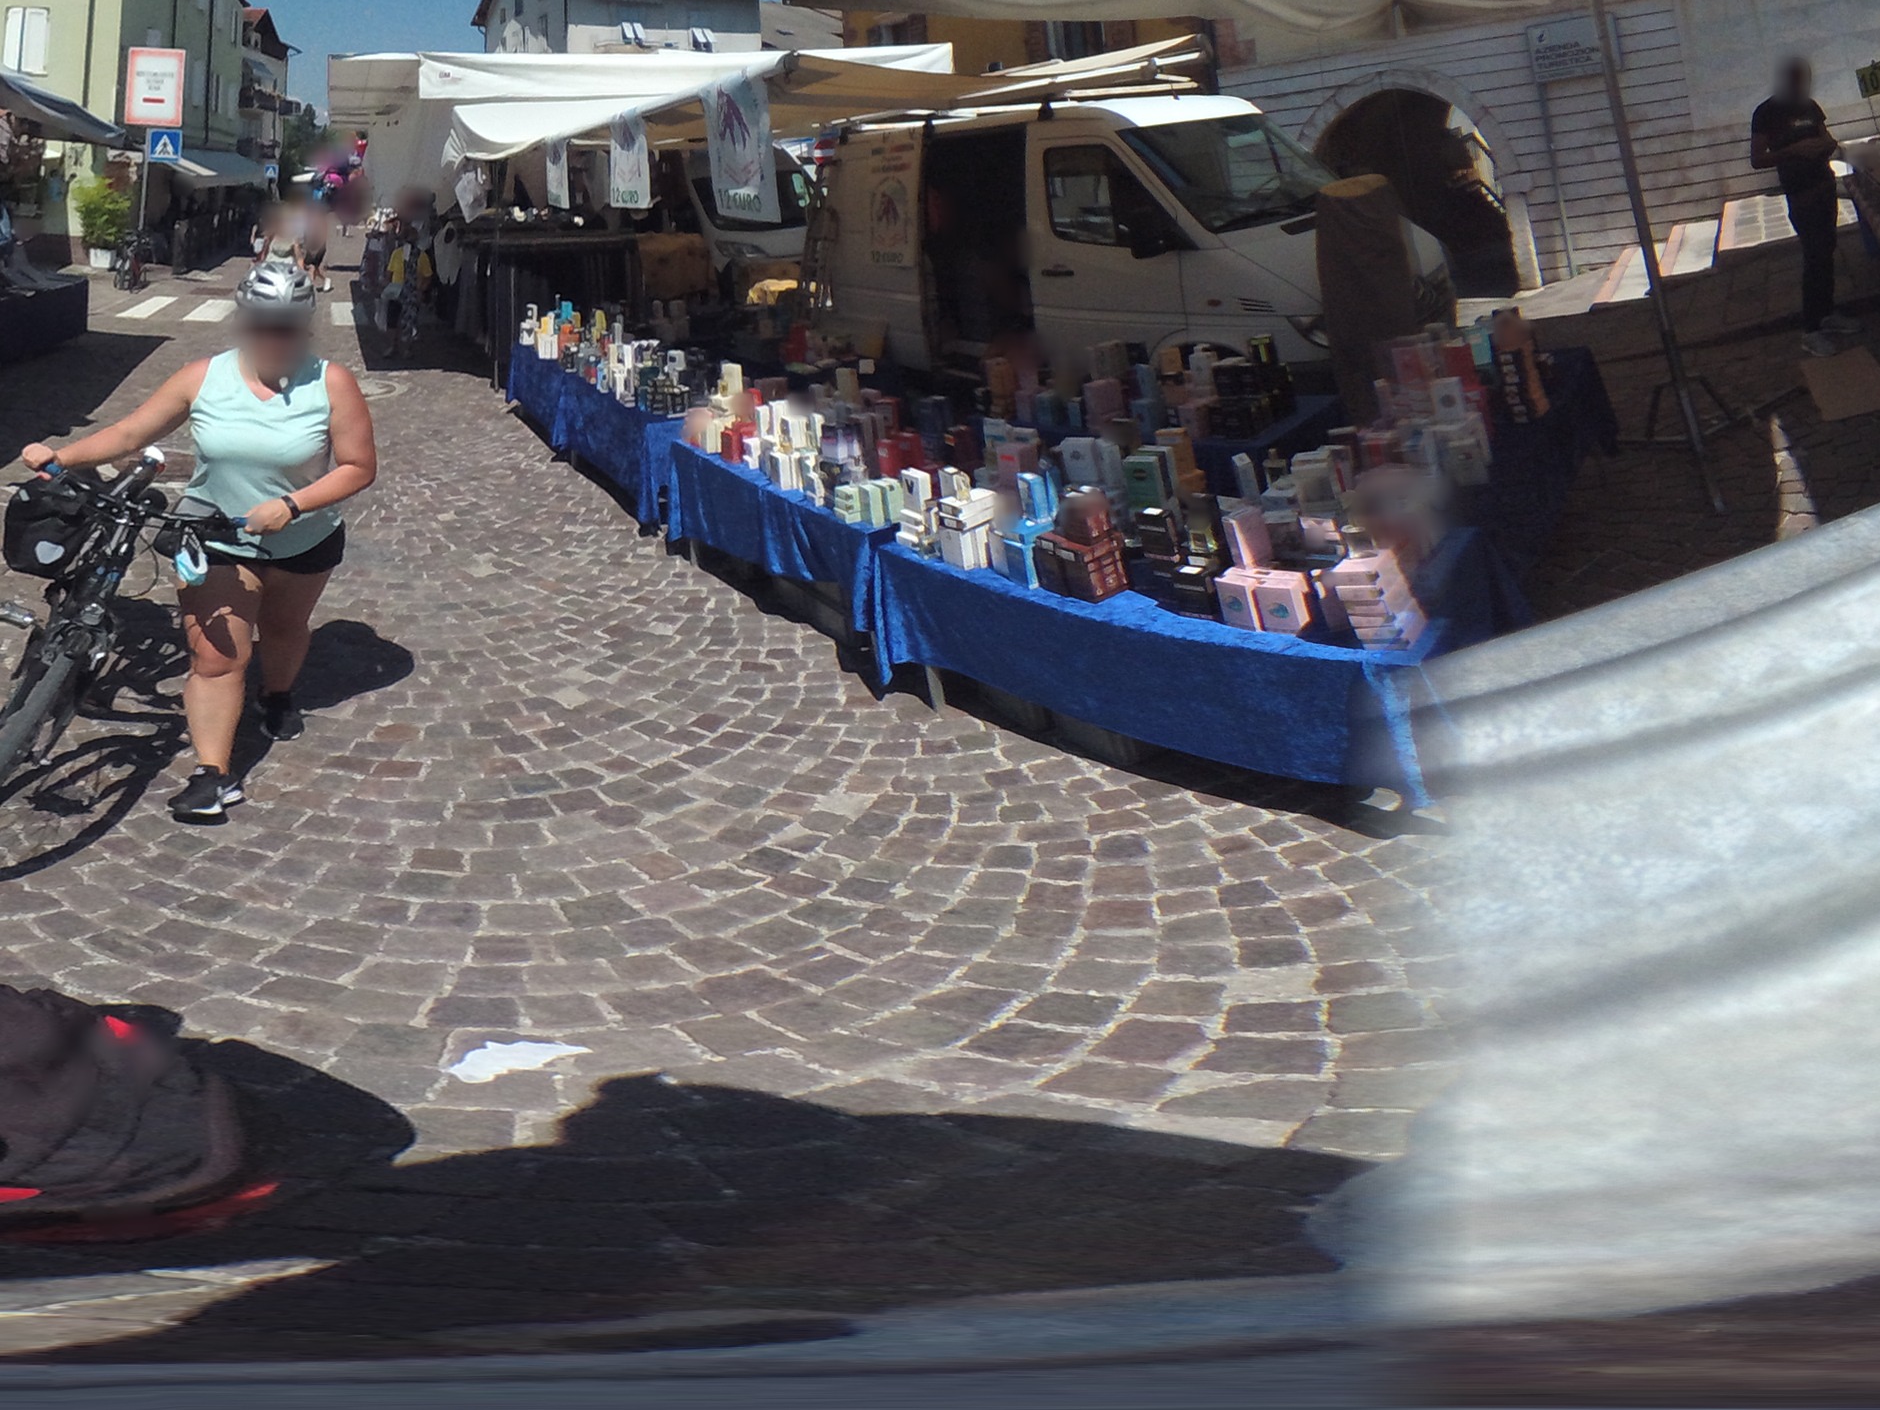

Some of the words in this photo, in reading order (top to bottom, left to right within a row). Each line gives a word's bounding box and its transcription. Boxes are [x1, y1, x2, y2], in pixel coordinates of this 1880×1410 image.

[1535, 42, 1580, 54] AZIENDA
[1535, 46, 1600, 62] PROMOZION
[1536, 56, 1594, 69] TURISTICA
[718, 189, 732, 210] 12
